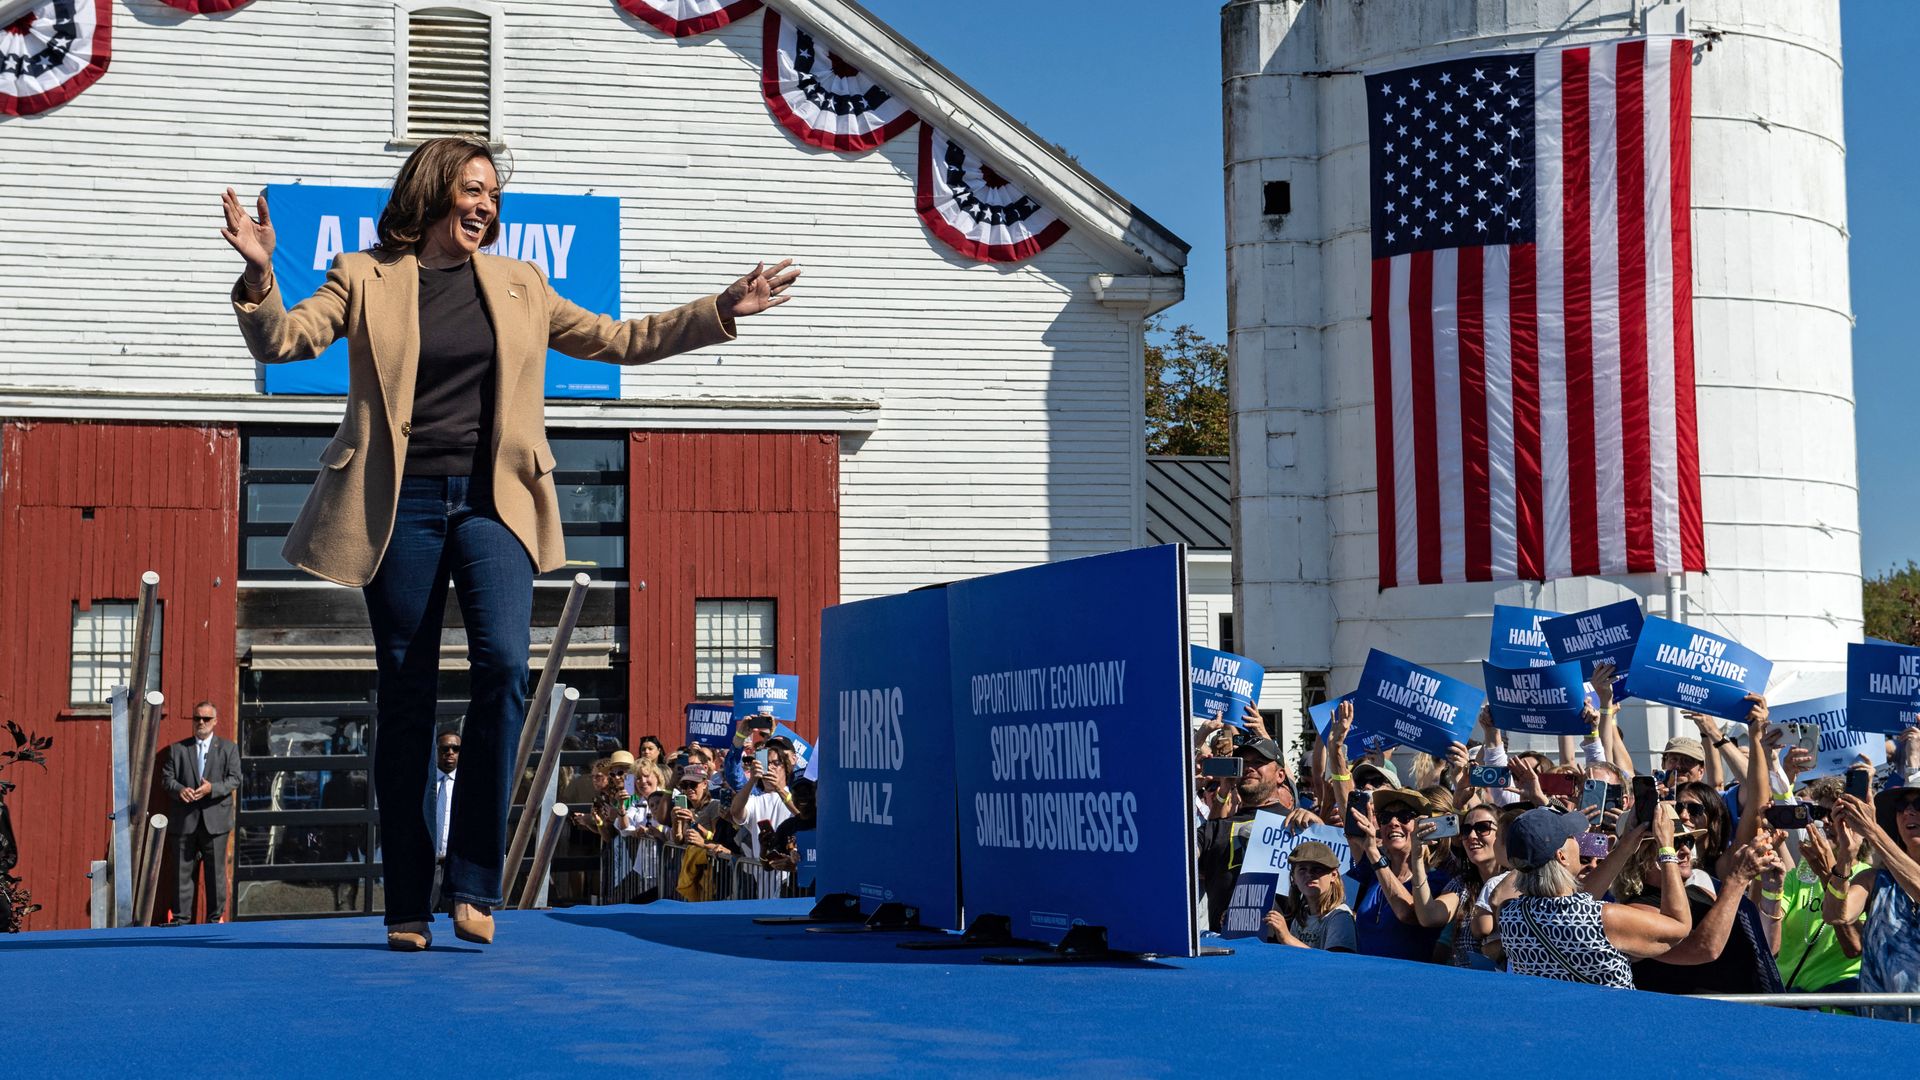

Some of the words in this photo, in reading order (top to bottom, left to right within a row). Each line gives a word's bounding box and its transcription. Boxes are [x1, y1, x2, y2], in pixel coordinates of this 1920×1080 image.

[1576, 613, 1604, 634] NEW
[1562, 624, 1631, 653] HAMPSHIRE
[1689, 633, 1726, 657] NEW
[1212, 656, 1240, 677] NEW
[1655, 643, 1748, 683] HAMPSHIRE
[1899, 655, 1920, 676] NE
[757, 678, 775, 688] NEW
[971, 667, 1047, 716] OPPORTUNITY
[1051, 660, 1127, 710] ECONOMY
[1191, 667, 1254, 699] HAMPSHIRE
[1406, 670, 1441, 697] NEW
[1512, 673, 1541, 689] NEW
[1677, 682, 1710, 699] HARRIS
[743, 688, 788, 699] HAMPSHIRE
[1377, 679, 1459, 725] HAMPSHIRE
[1495, 686, 1567, 705] HAMPSHIRE
[1681, 694, 1702, 705] WALZ
[1204, 698, 1229, 712] HARRIS
[693, 709, 711, 722] NEW
[711, 710, 732, 725] WAY
[1394, 718, 1422, 737] HARRIS
[1521, 714, 1547, 724] HARRIS
[689, 722, 728, 736] FORWARD
[839, 686, 904, 771] HARRIS
[1397, 730, 1416, 742] WALZ
[990, 719, 1101, 781] SUPPORTING
[848, 781, 893, 825] WALZ
[975, 791, 1021, 849] SMALL
[1023, 791, 1138, 853] BUSINESSES
[1248, 884, 1269, 907] WAY
[1227, 908, 1260, 931] FORWARD
